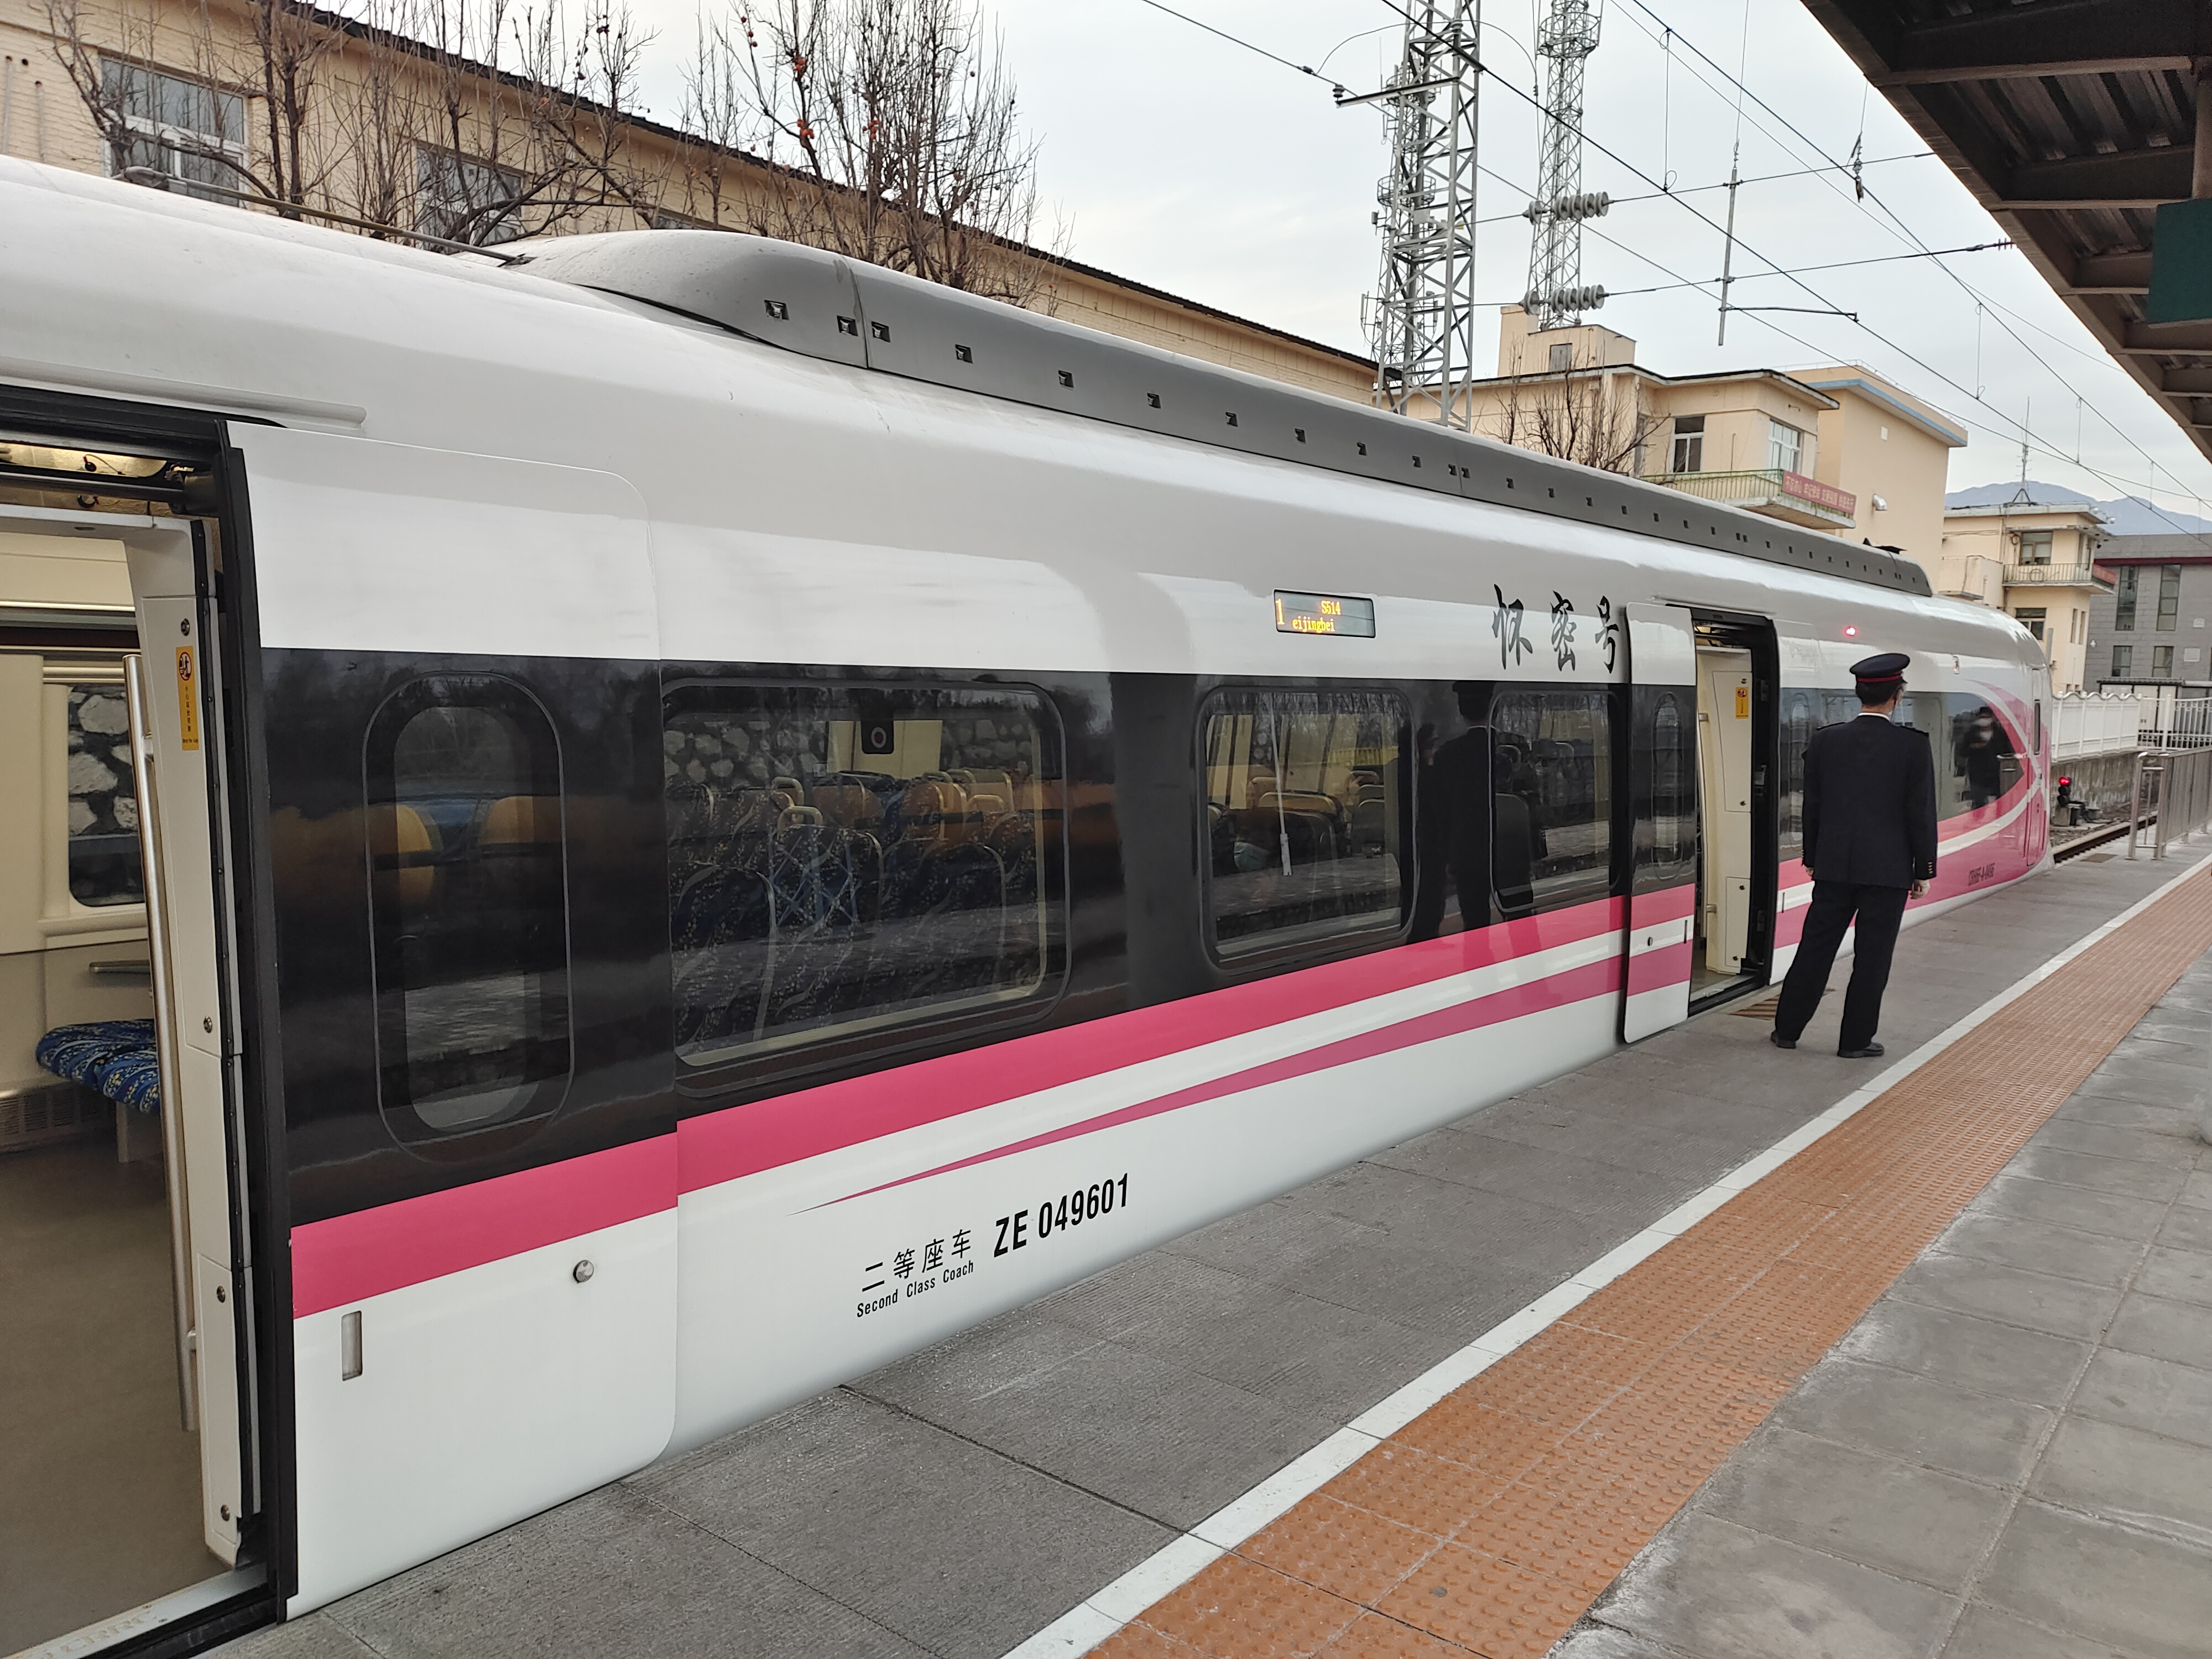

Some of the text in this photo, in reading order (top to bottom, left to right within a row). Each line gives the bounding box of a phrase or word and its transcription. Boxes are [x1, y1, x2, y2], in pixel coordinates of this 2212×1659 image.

[1276, 598, 1285, 625] 1
[1321, 600, 1341, 615] S514
[994, 1173, 1128, 1258] ZE 049601
[857, 1260, 974, 1318] Second Class Coach
[862, 1229, 972, 1292] 二等座车
